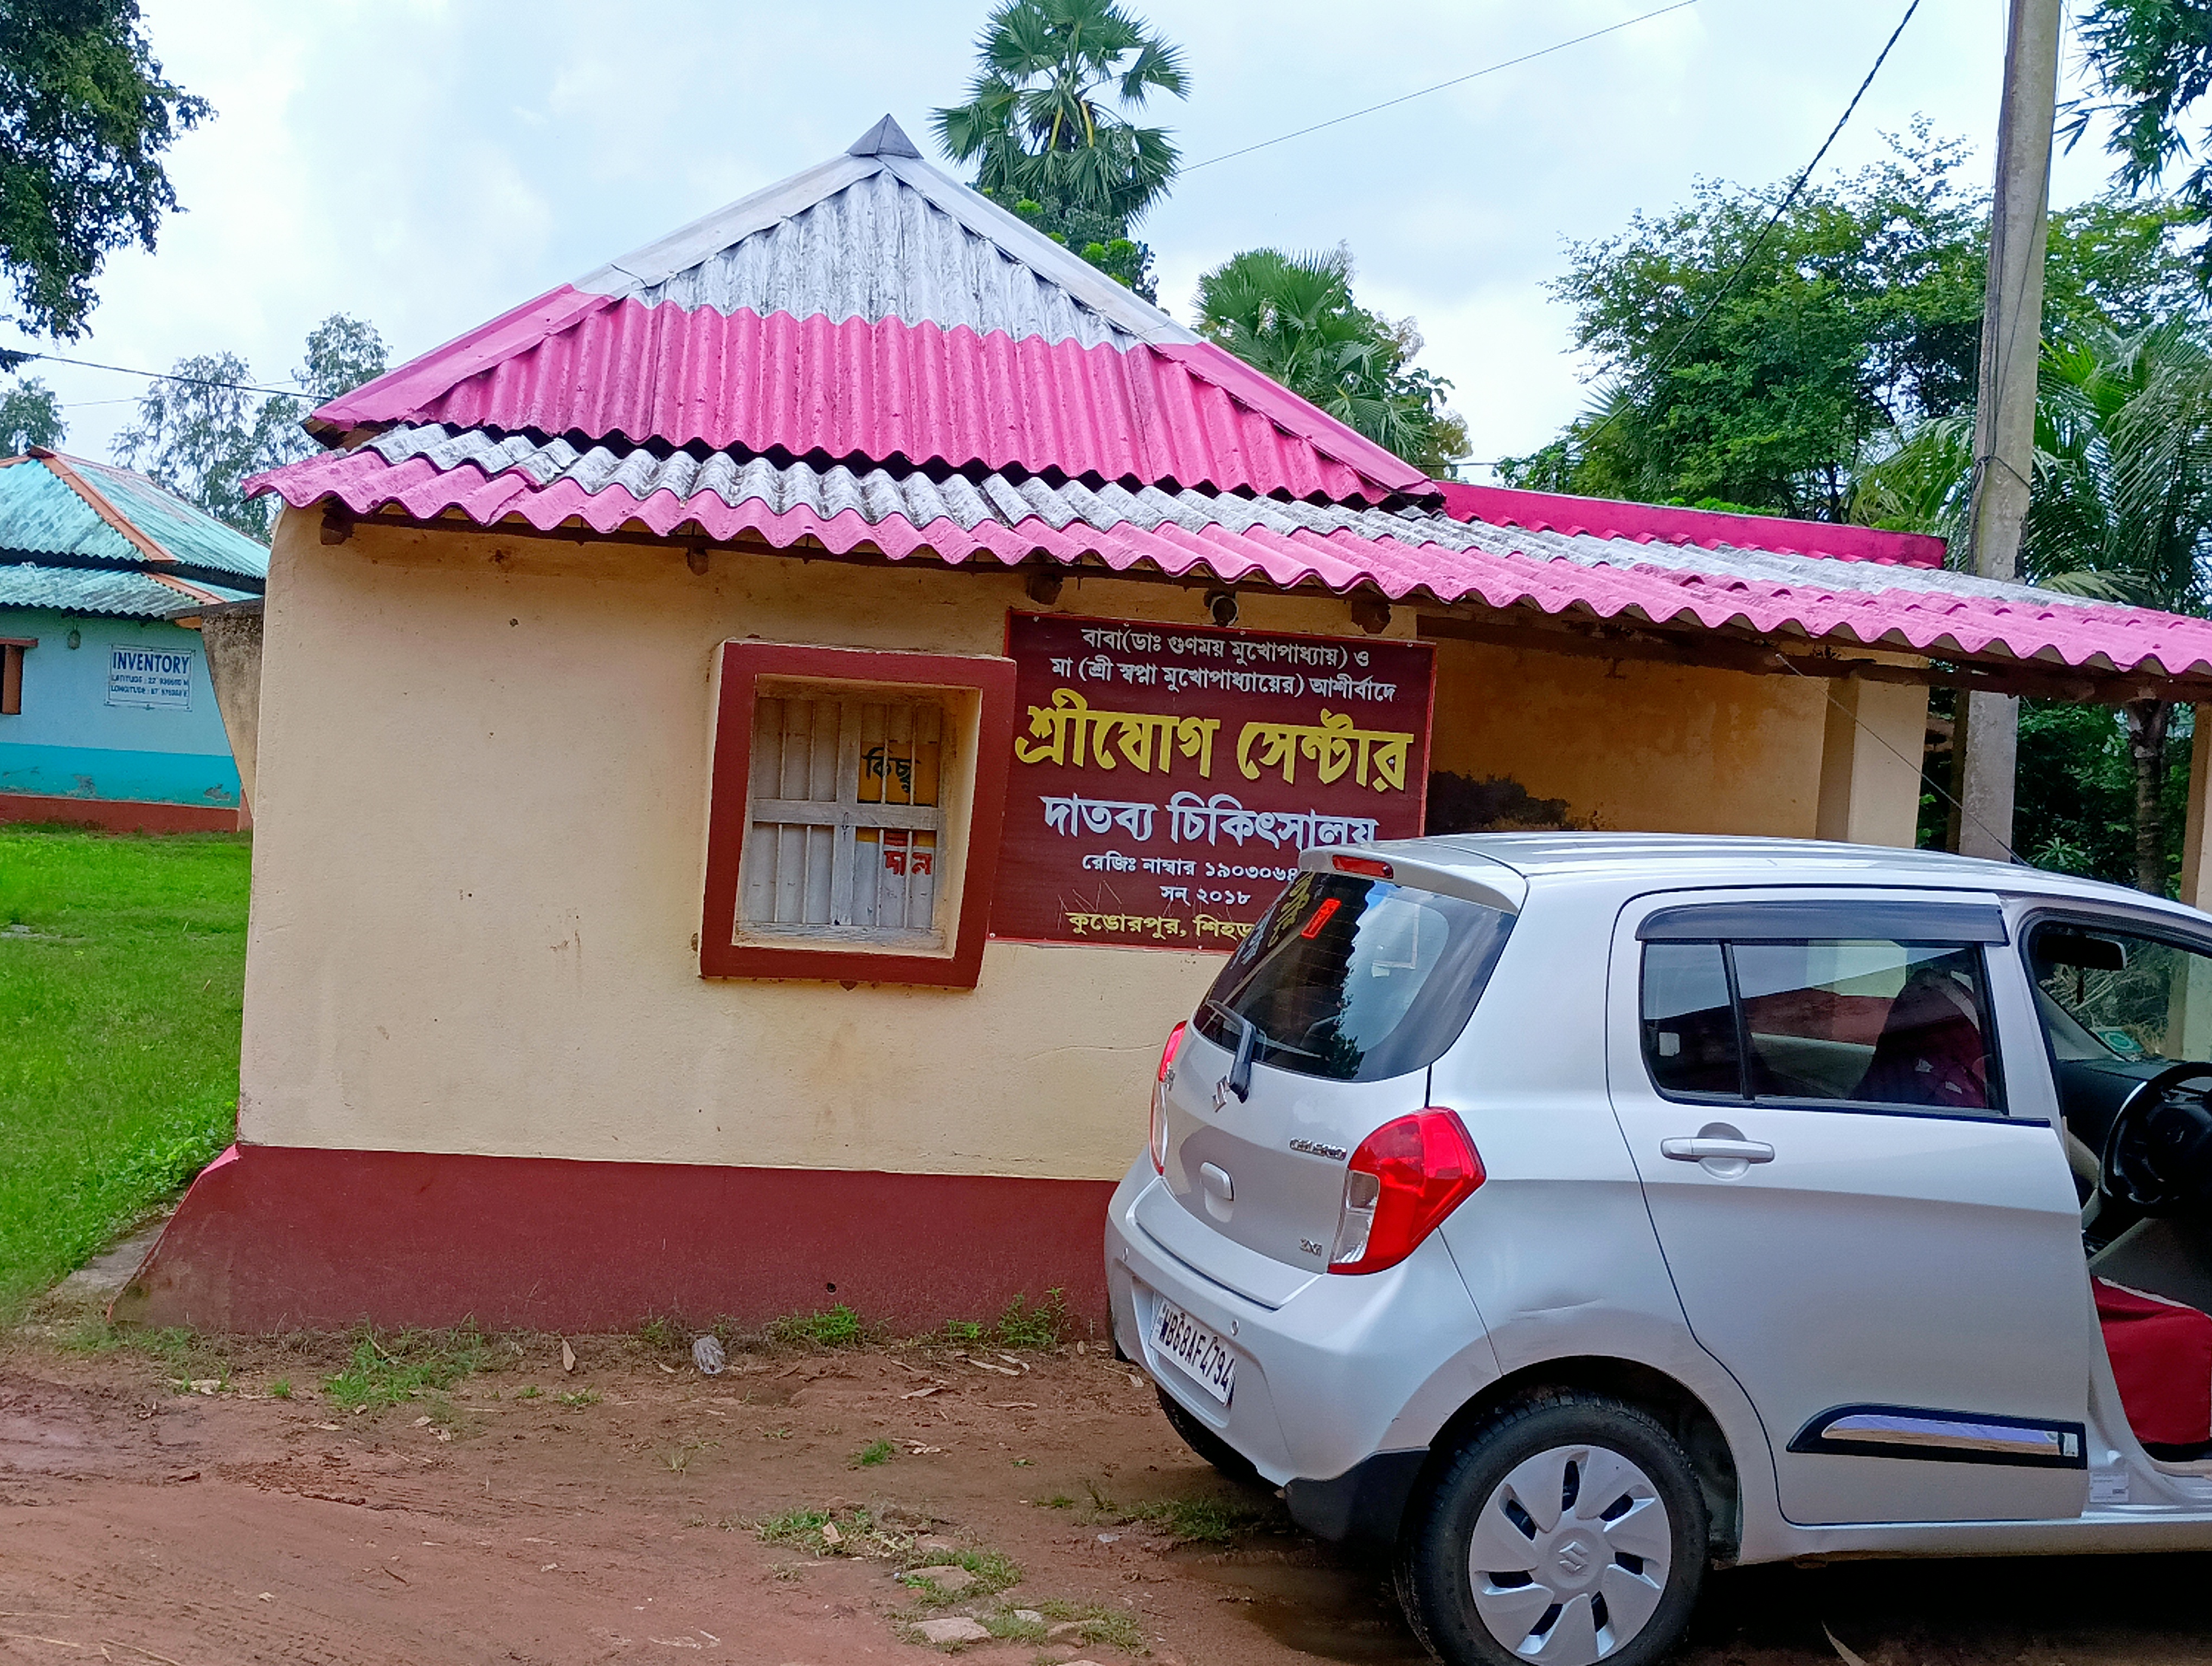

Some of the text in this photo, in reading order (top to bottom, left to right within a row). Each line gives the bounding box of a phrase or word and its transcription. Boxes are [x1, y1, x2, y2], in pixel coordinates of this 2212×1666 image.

[113, 652, 189, 674] INVENTORY
[1354, 651, 1369, 667] ও
[1050, 657, 1073, 678] মা
[1308, 673, 1397, 702] আশীর্বাদে
[1014, 688, 1414, 792] শ্রীযোগ সেন্টার
[1037, 792, 1160, 841] দাতব্য
[1141, 856, 1198, 876] নাম্বার
[1197, 888, 1251, 905] ২০১৮
